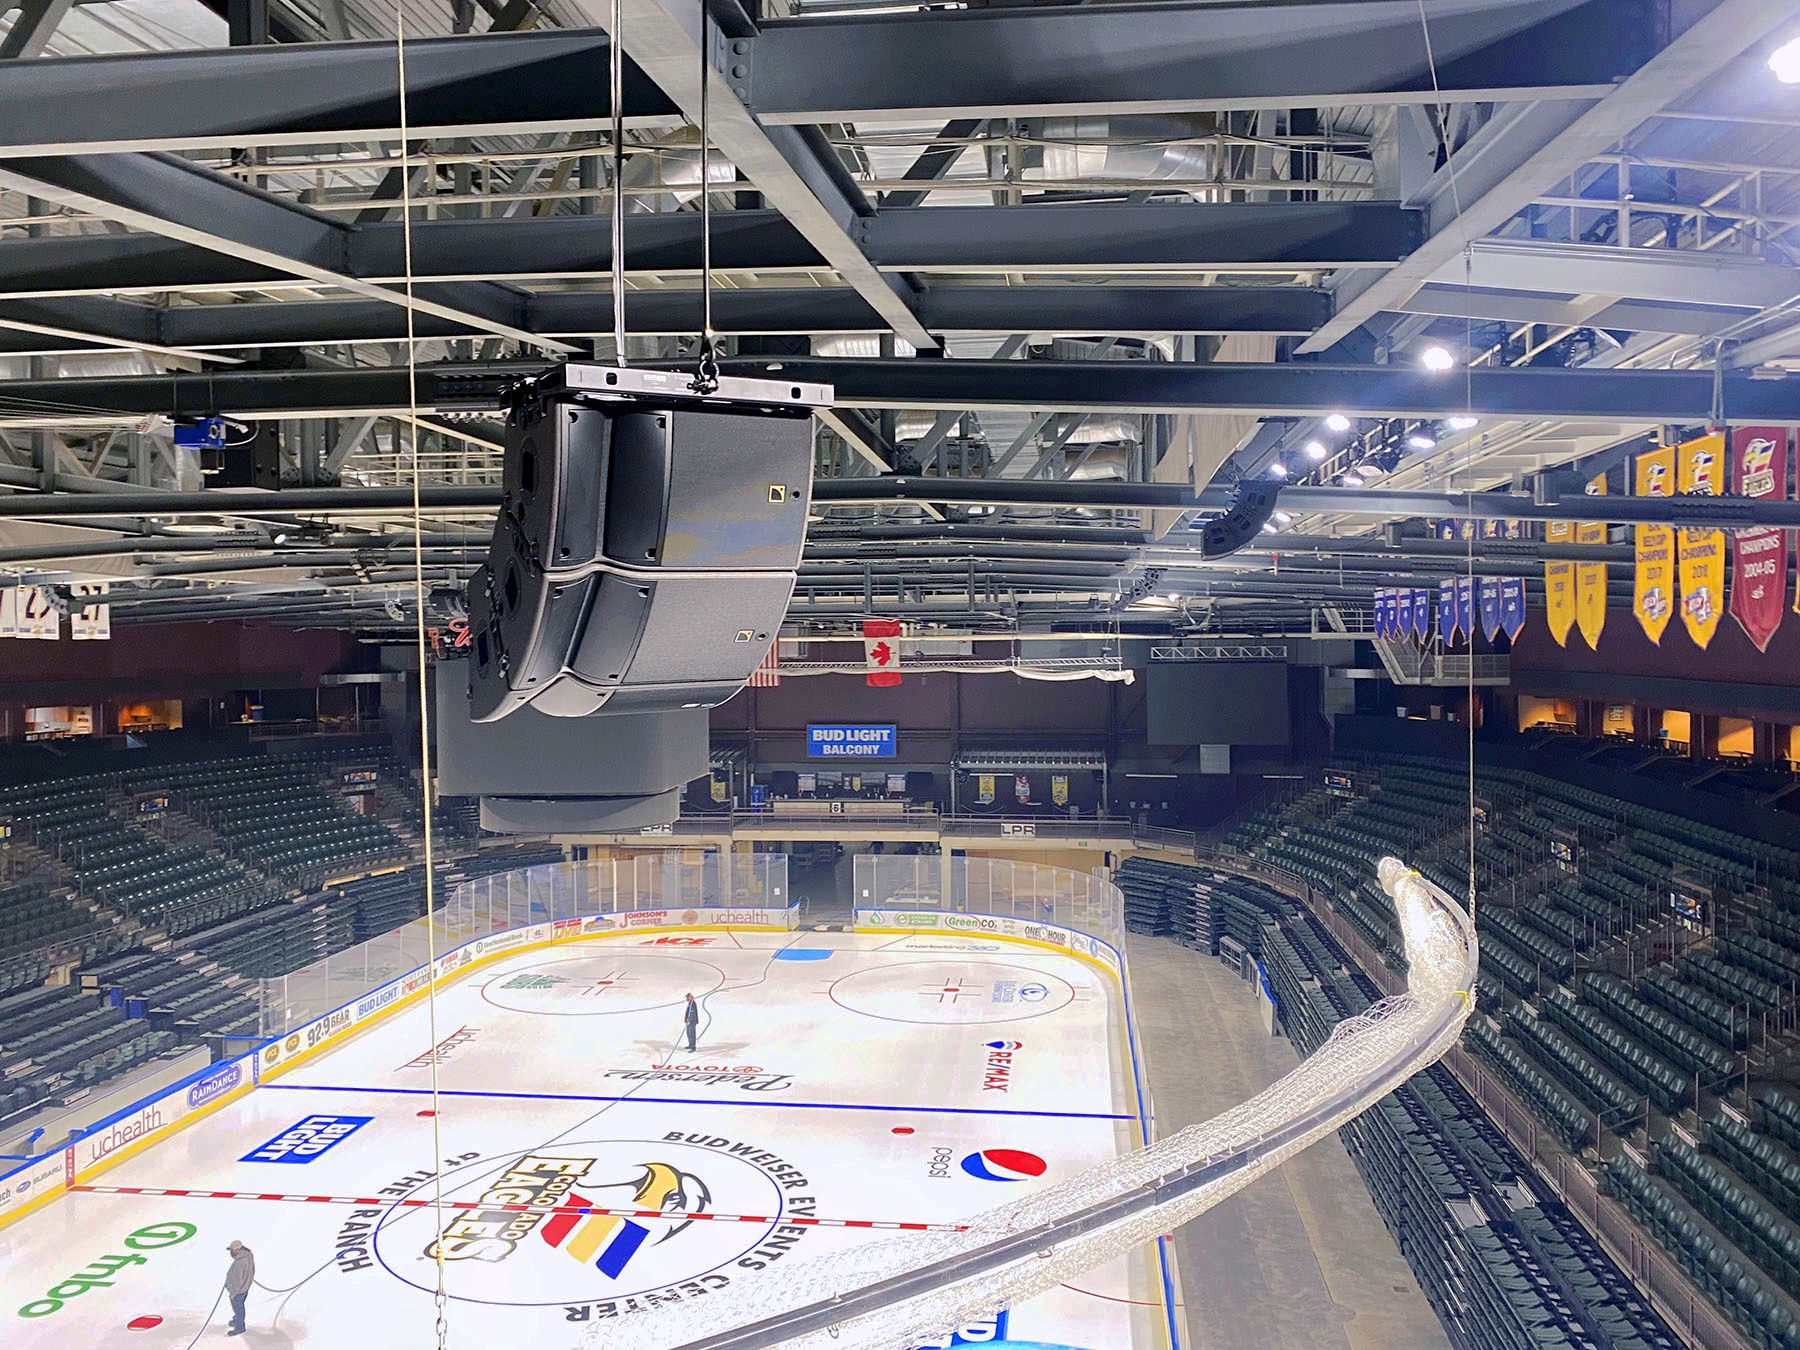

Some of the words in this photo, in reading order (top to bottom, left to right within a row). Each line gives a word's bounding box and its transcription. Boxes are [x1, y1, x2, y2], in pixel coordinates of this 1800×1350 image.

[812, 729, 844, 741] BUD
[846, 729, 891, 742] LIGHT
[823, 744, 880, 756] BALCONY
[1002, 825, 1035, 835] LPR
[710, 909, 769, 925] uchealth
[949, 917, 978, 928] Green
[1024, 925, 1040, 937] ONE
[1047, 929, 1067, 943] HOUR
[358, 999, 375, 1016] BUD
[375, 986, 399, 1007] LIGHT
[307, 1016, 331, 1048] 92.9
[331, 1009, 350, 1029] BEAR
[652, 1064, 729, 1072] TOYOTA
[982, 1051, 1013, 1094] RE/MAX
[191, 1069, 238, 1103] RAINDANCE
[91, 1104, 162, 1161] uchealth
[252, 1116, 339, 1161] LIGHT
[293, 1123, 358, 1155] BUD
[33, 1164, 63, 1185] SUBARU
[444, 1151, 481, 1167] at
[927, 1146, 953, 1179] pepsi
[377, 1169, 439, 1197] THE
[499, 1174, 576, 1241] COLOADO
[662, 1131, 809, 1191] BUDWEISER
[737, 1195, 816, 1271] EVENTS
[335, 1208, 383, 1274] RANCH
[17, 1253, 148, 1318] fnbo
